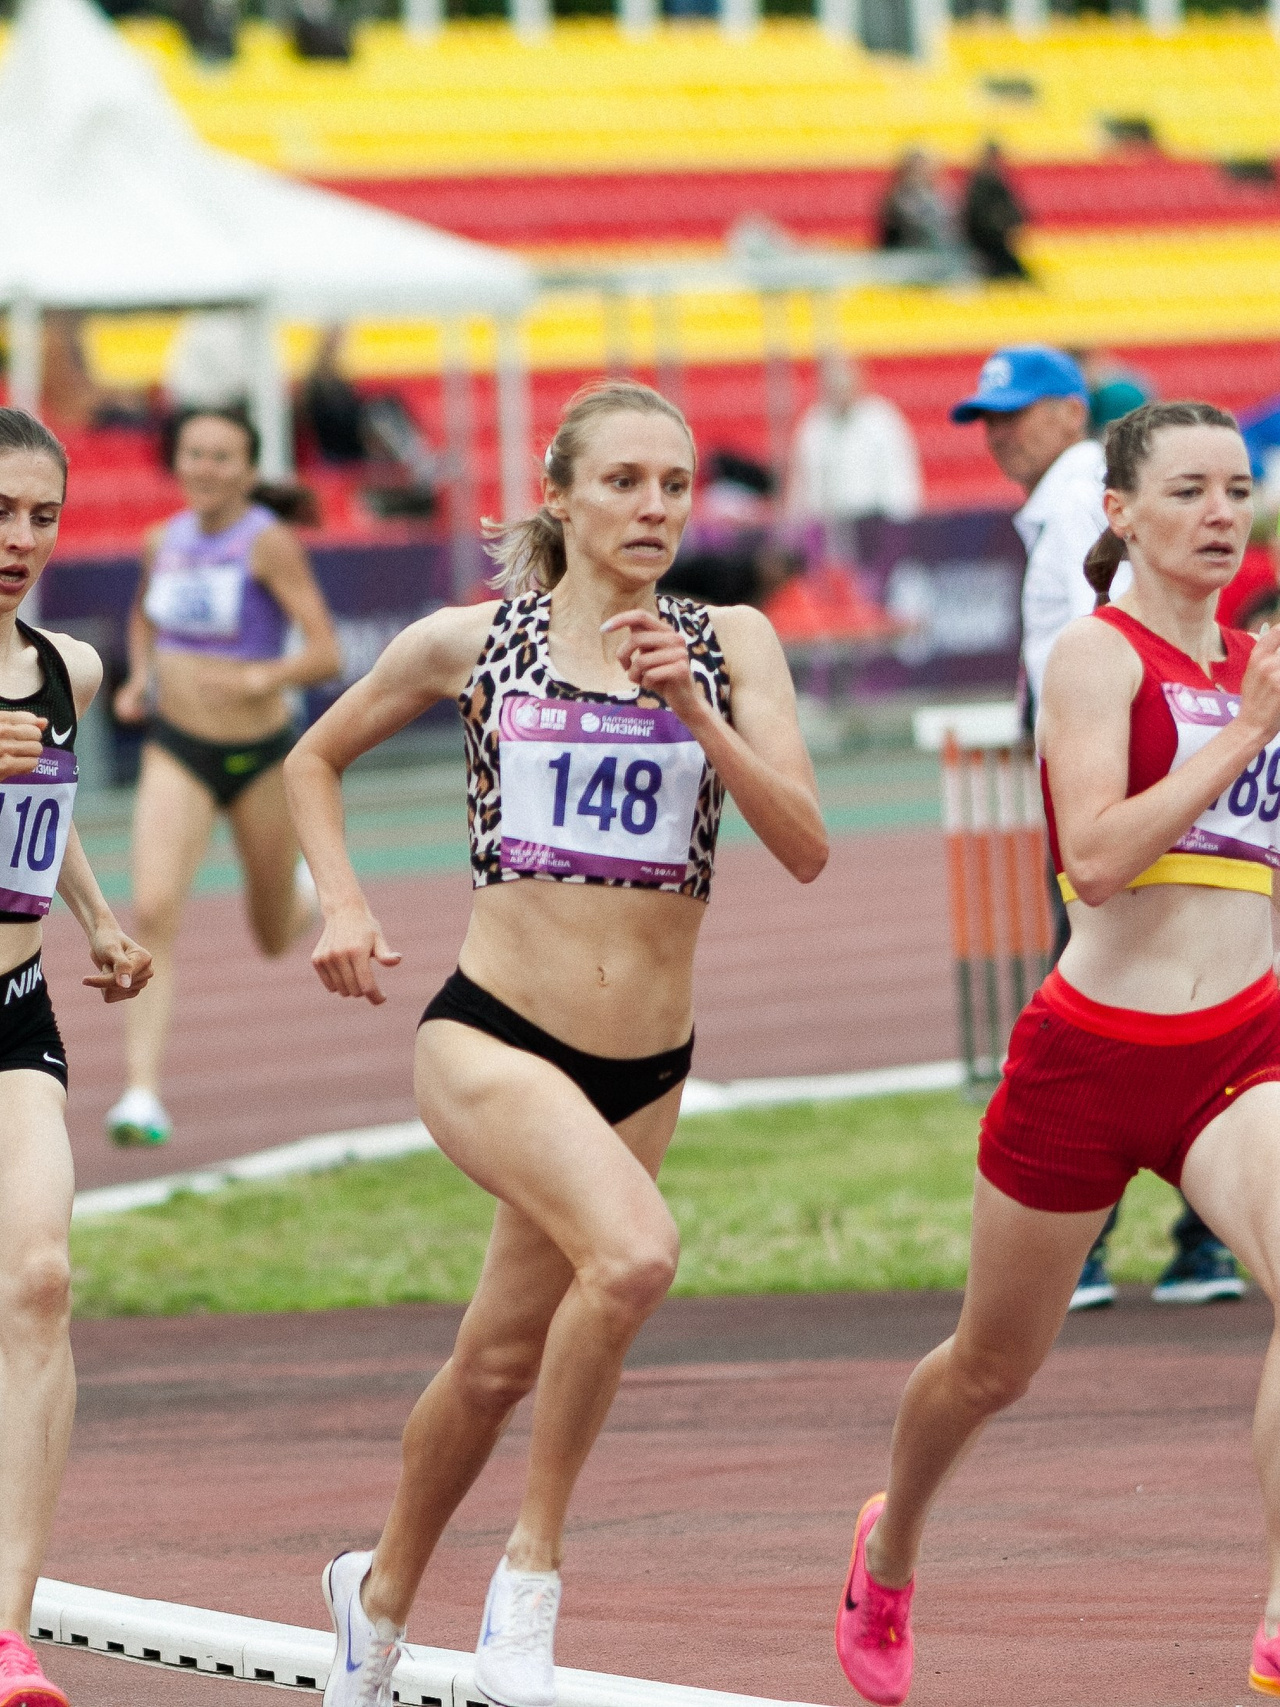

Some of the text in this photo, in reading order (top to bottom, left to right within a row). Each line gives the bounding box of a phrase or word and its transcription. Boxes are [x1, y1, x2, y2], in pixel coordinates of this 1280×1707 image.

[600, 721, 655, 737] ЛИЗИНГ
[549, 752, 662, 835] 148
[1207, 747, 1280, 822] 89
[4, 955, 42, 1005] NIK
